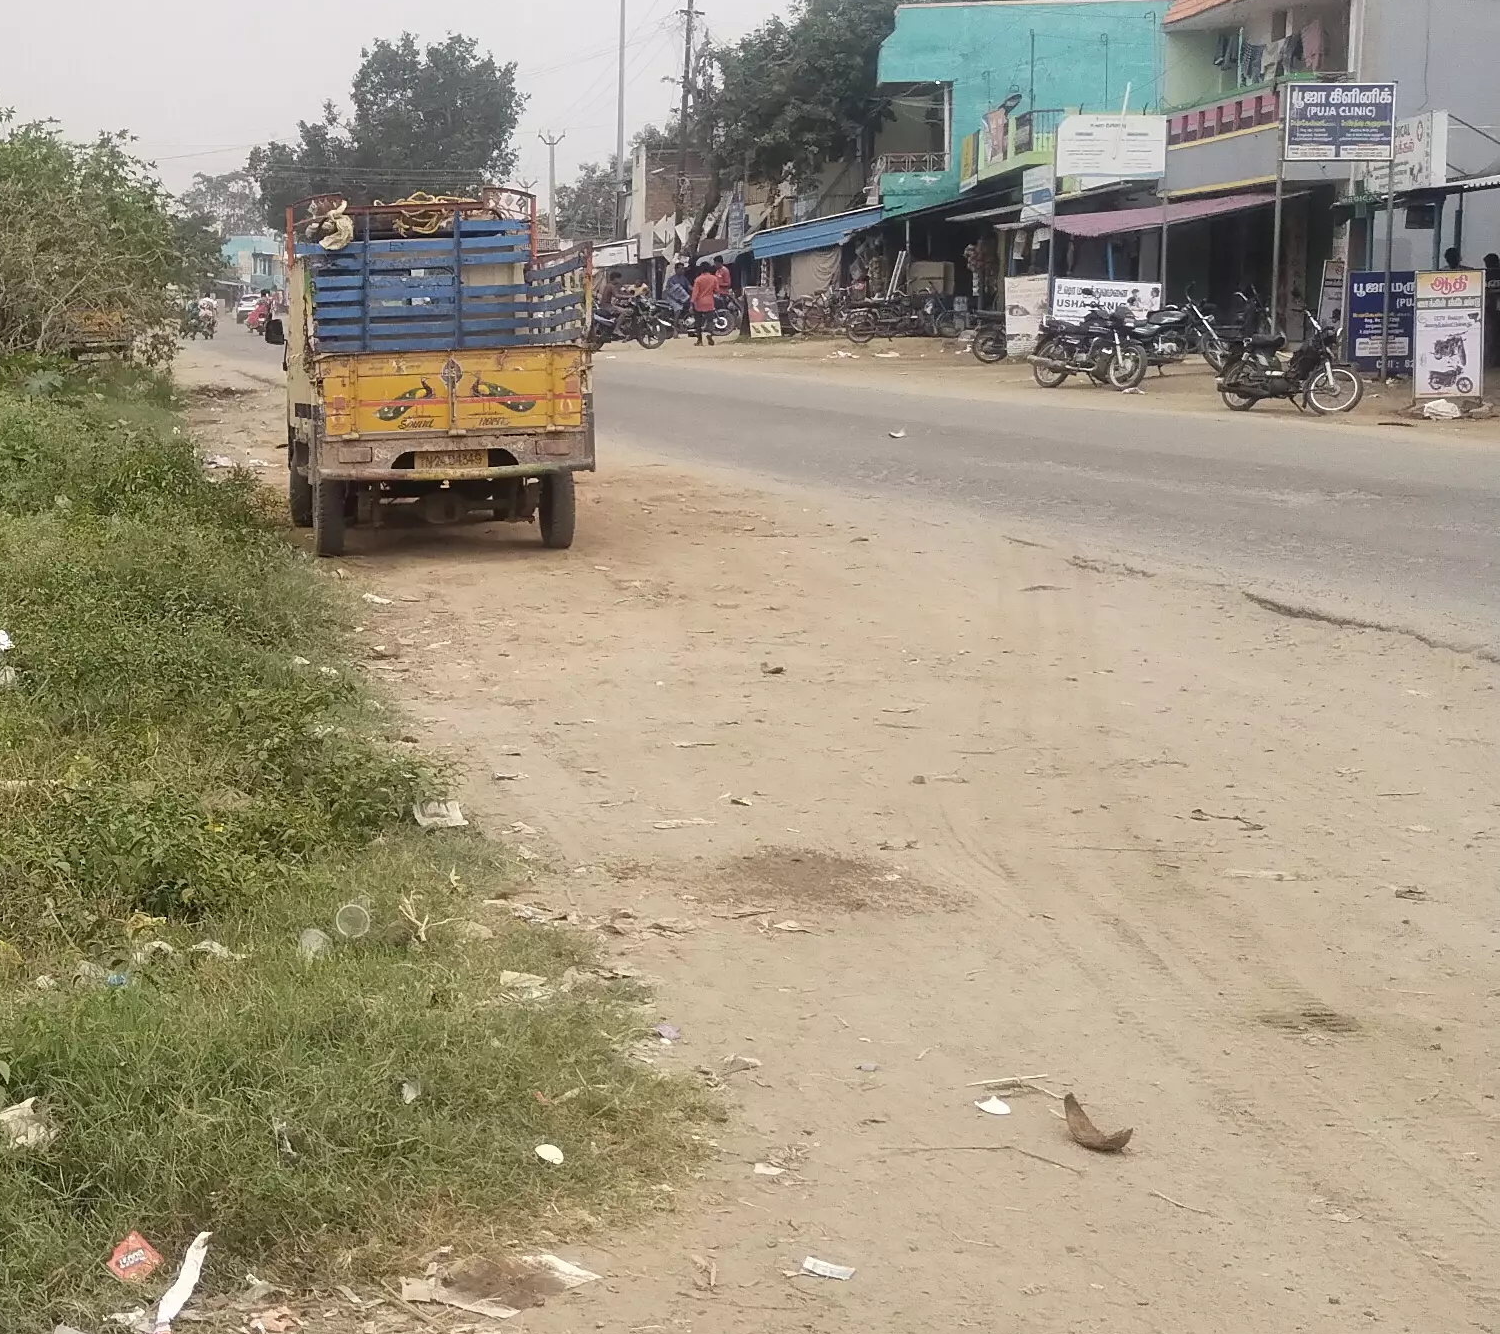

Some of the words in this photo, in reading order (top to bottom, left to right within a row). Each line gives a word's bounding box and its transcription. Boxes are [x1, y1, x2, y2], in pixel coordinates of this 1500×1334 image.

[1292, 87, 1327, 108] பூஜா
[1329, 87, 1392, 104] கிளினிக்
[1307, 106, 1336, 117] (PUJA
[1339, 106, 1376, 117] CLINIC)
[1057, 299, 1085, 308] USHA
